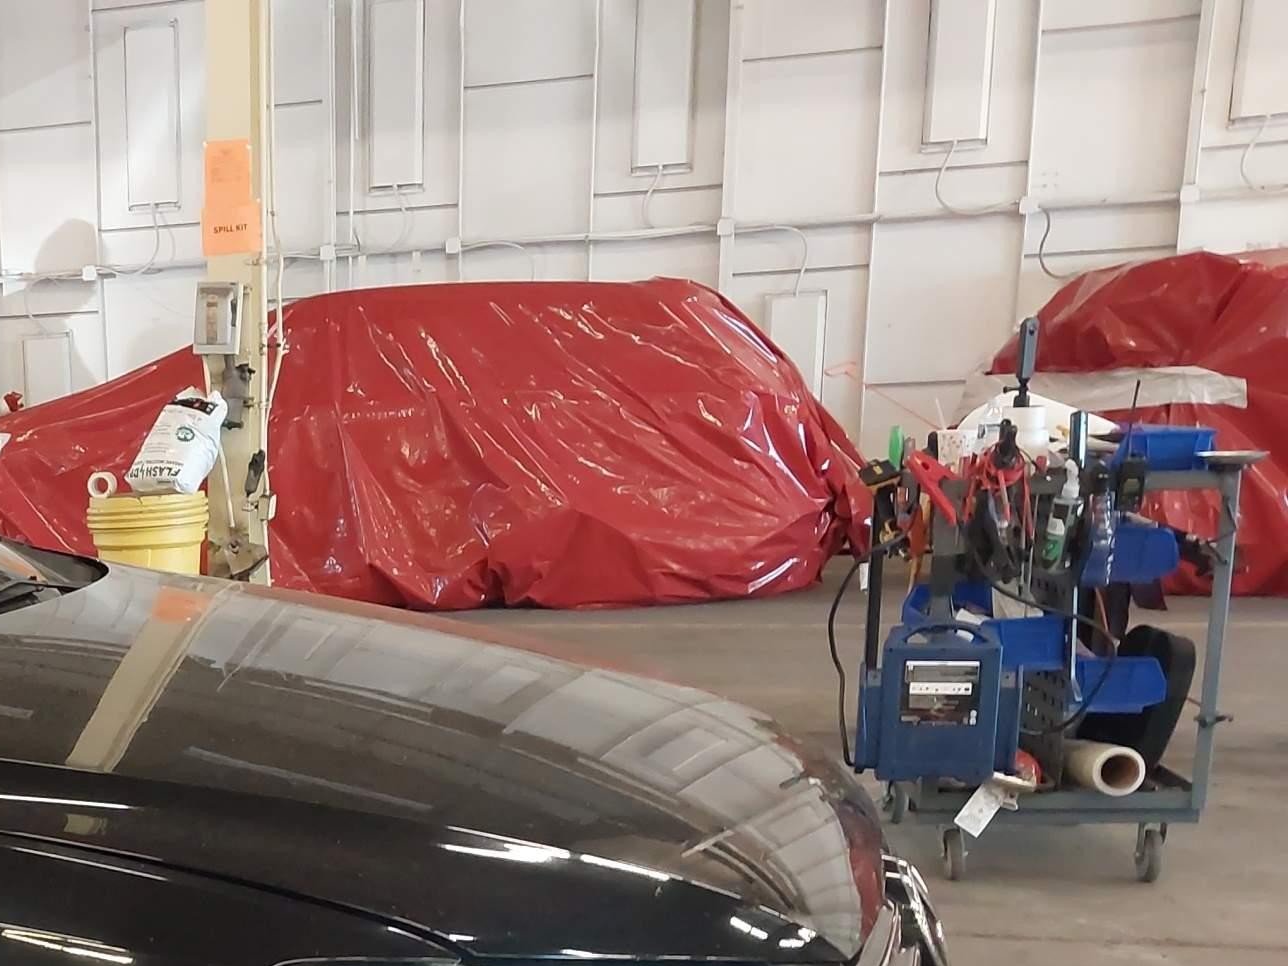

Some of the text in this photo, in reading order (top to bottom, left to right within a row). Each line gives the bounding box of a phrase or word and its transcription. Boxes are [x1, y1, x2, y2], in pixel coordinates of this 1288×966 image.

[213, 223, 248, 234] SPILL KIT
[146, 464, 181, 477] FLASH
